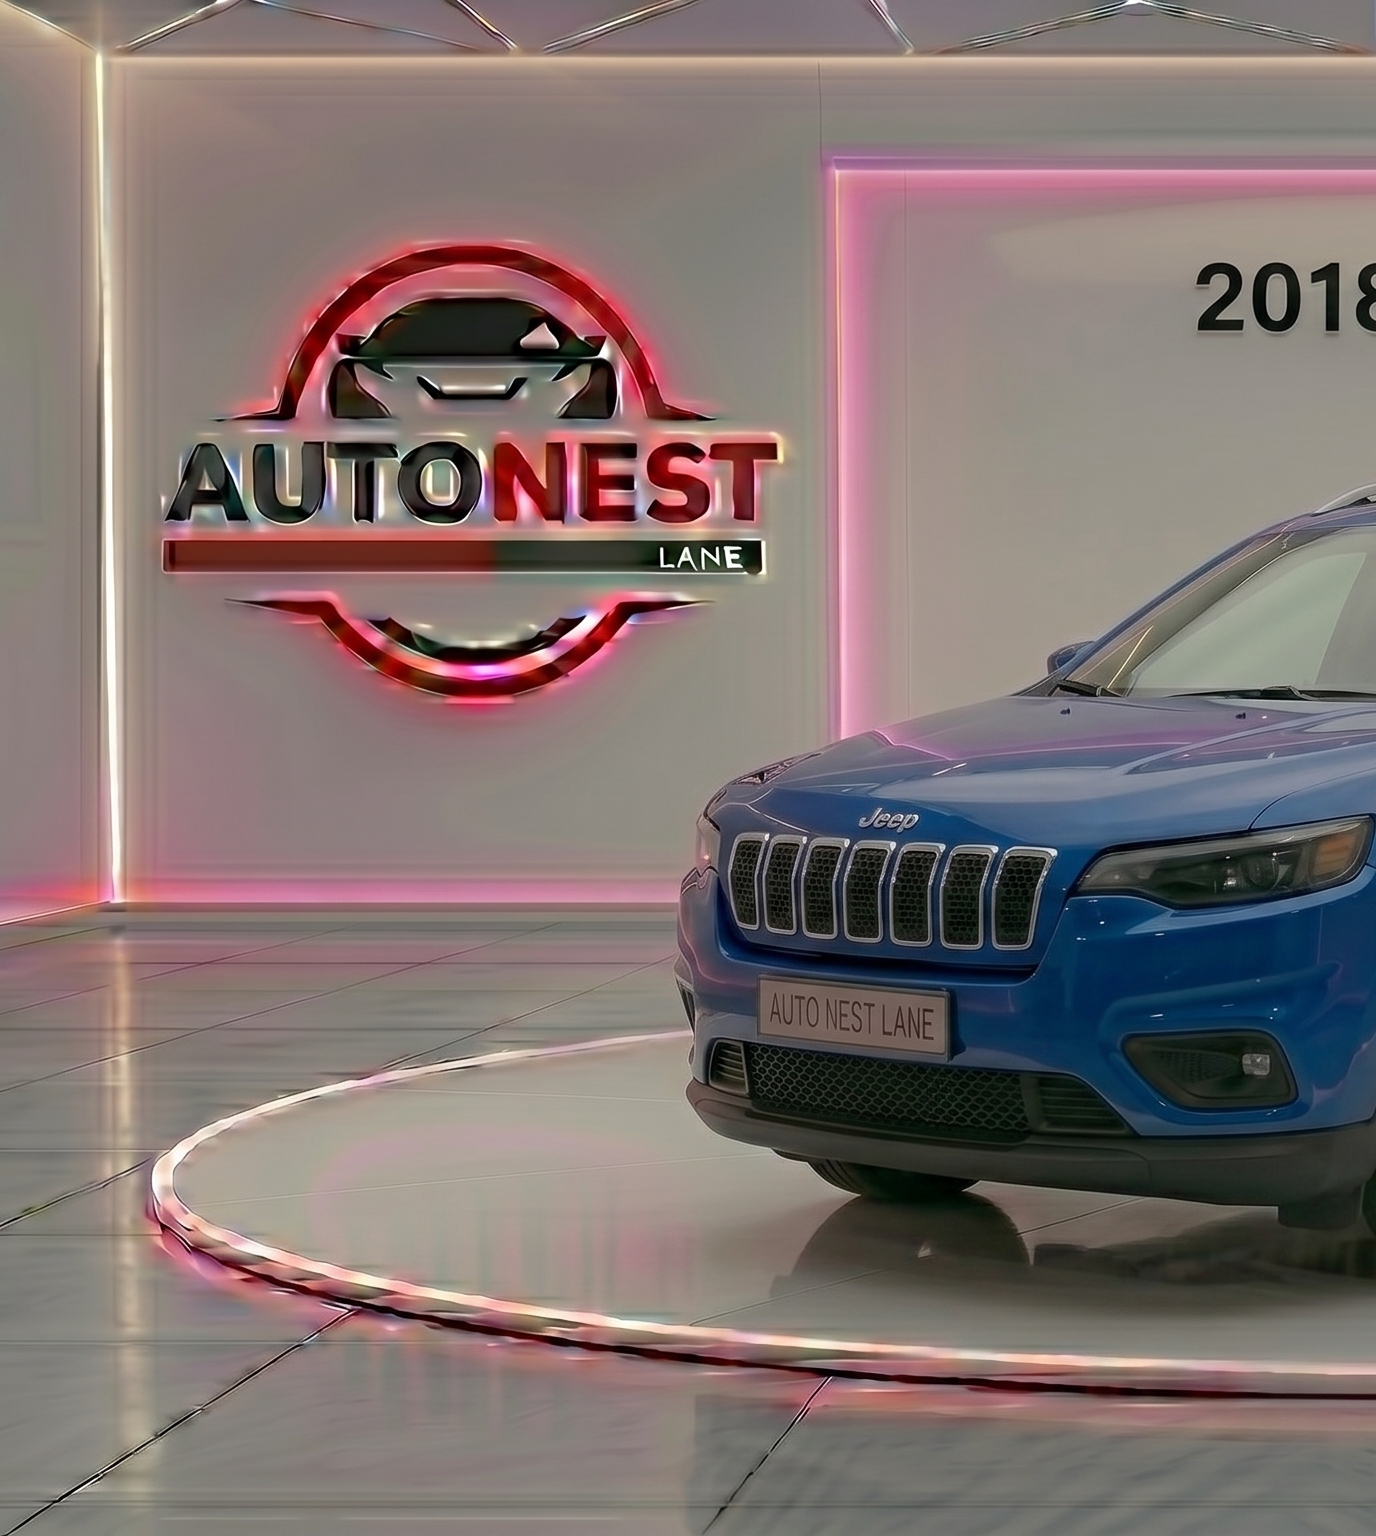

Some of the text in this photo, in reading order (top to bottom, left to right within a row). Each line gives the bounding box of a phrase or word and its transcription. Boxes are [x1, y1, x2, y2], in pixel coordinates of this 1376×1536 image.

[164, 440, 779, 524] AUTONEST
[658, 545, 745, 571] LANE
[858, 807, 919, 833] Jeep
[770, 991, 935, 1041] AUTO NEST LANE
